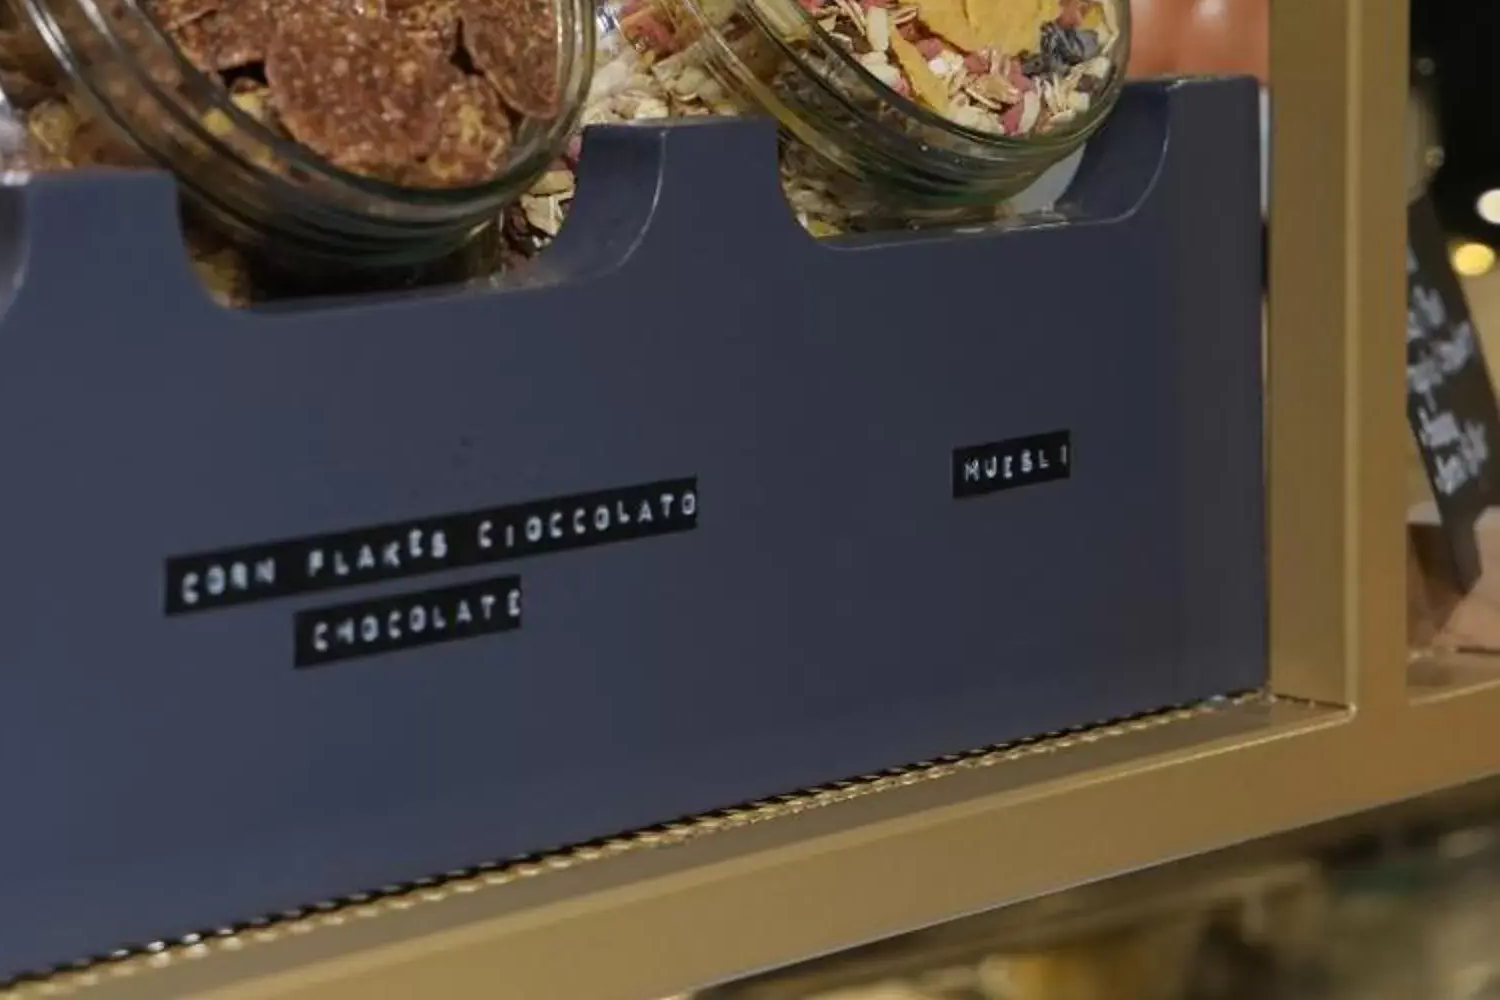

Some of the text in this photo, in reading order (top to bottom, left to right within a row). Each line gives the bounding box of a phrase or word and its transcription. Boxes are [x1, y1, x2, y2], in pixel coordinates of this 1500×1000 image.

[182, 490, 697, 605] CORN FLAKES CIOCCOLATO
[313, 588, 521, 652] CHOCOLATE
